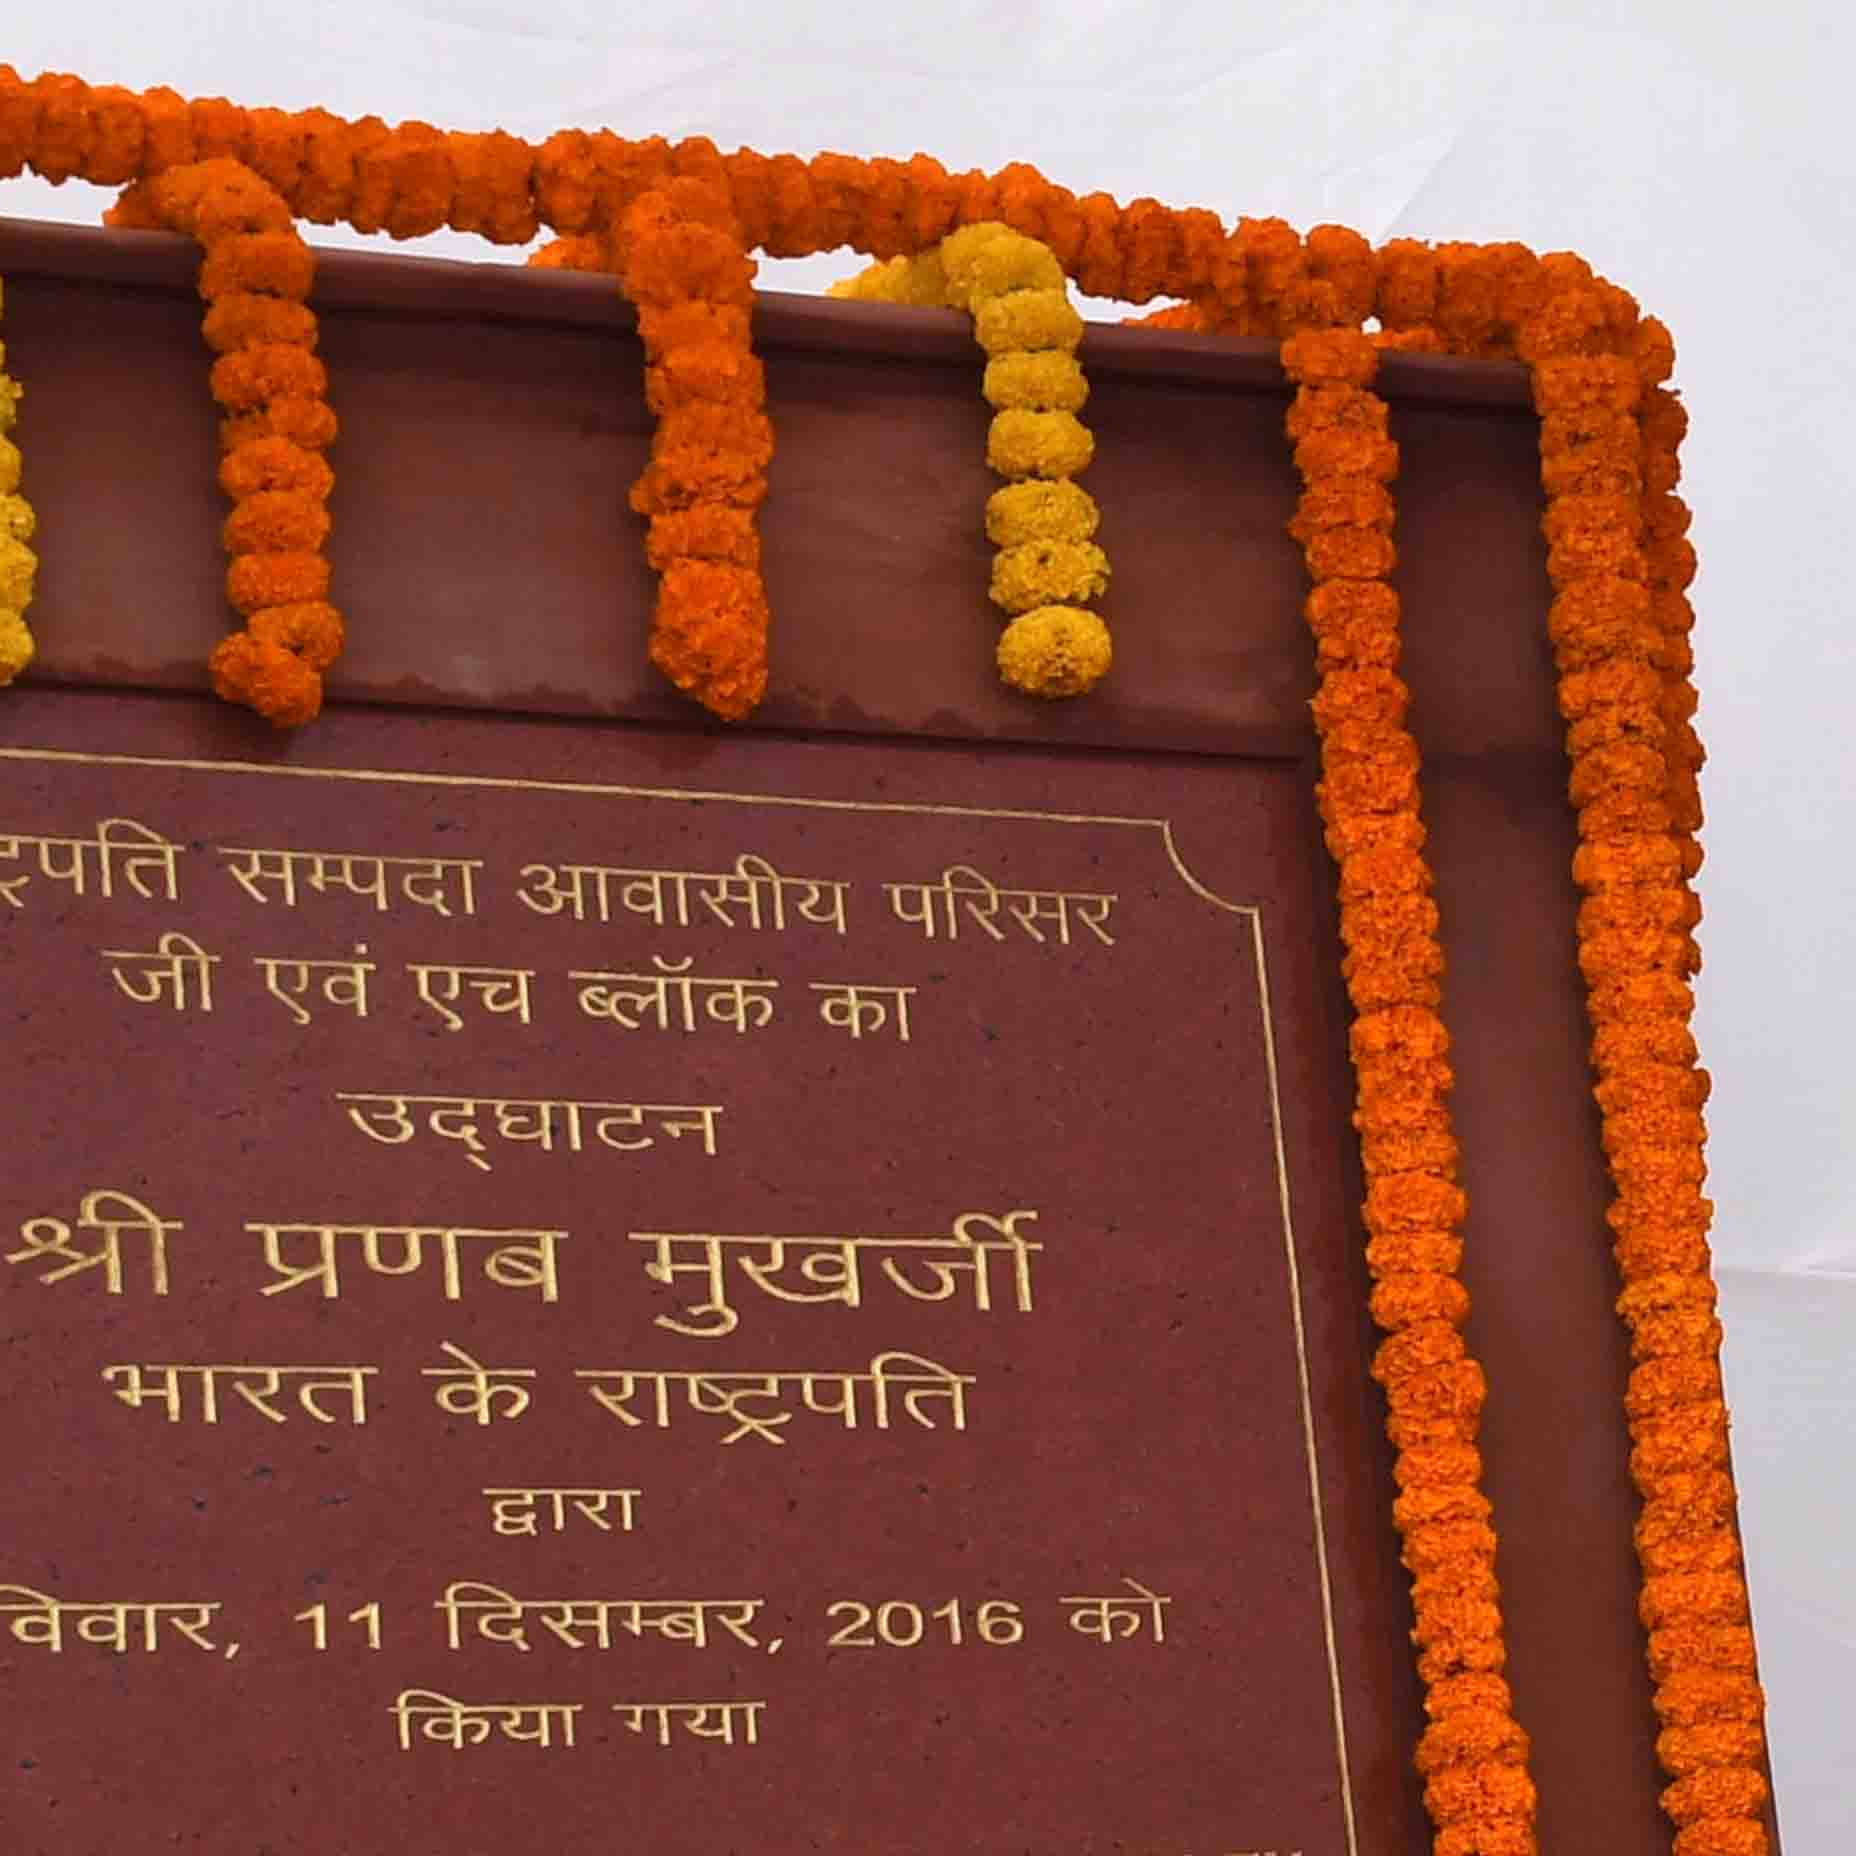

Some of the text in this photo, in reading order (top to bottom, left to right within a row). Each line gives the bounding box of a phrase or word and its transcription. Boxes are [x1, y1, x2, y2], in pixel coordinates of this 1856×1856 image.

[217, 846, 485, 918] सम्पदा
[515, 852, 851, 936] आवासीय
[880, 864, 1119, 947] परिसर
[100, 931, 918, 1042] जी एवं एच ब्लॉक का
[3, 1188, 1045, 1338] श्री प्रणब मुखर्जी
[100, 1340, 978, 1446] भारत के राष्ट्रपति
[481, 1486, 643, 1538] द्वारा
[293, 1601, 382, 1651] 11
[432, 1580, 784, 1655] दिसम्बर,
[825, 1597, 1025, 1648] 2016
[1058, 1576, 1173, 1644] को
[386, 1687, 768, 1751] किया गया
